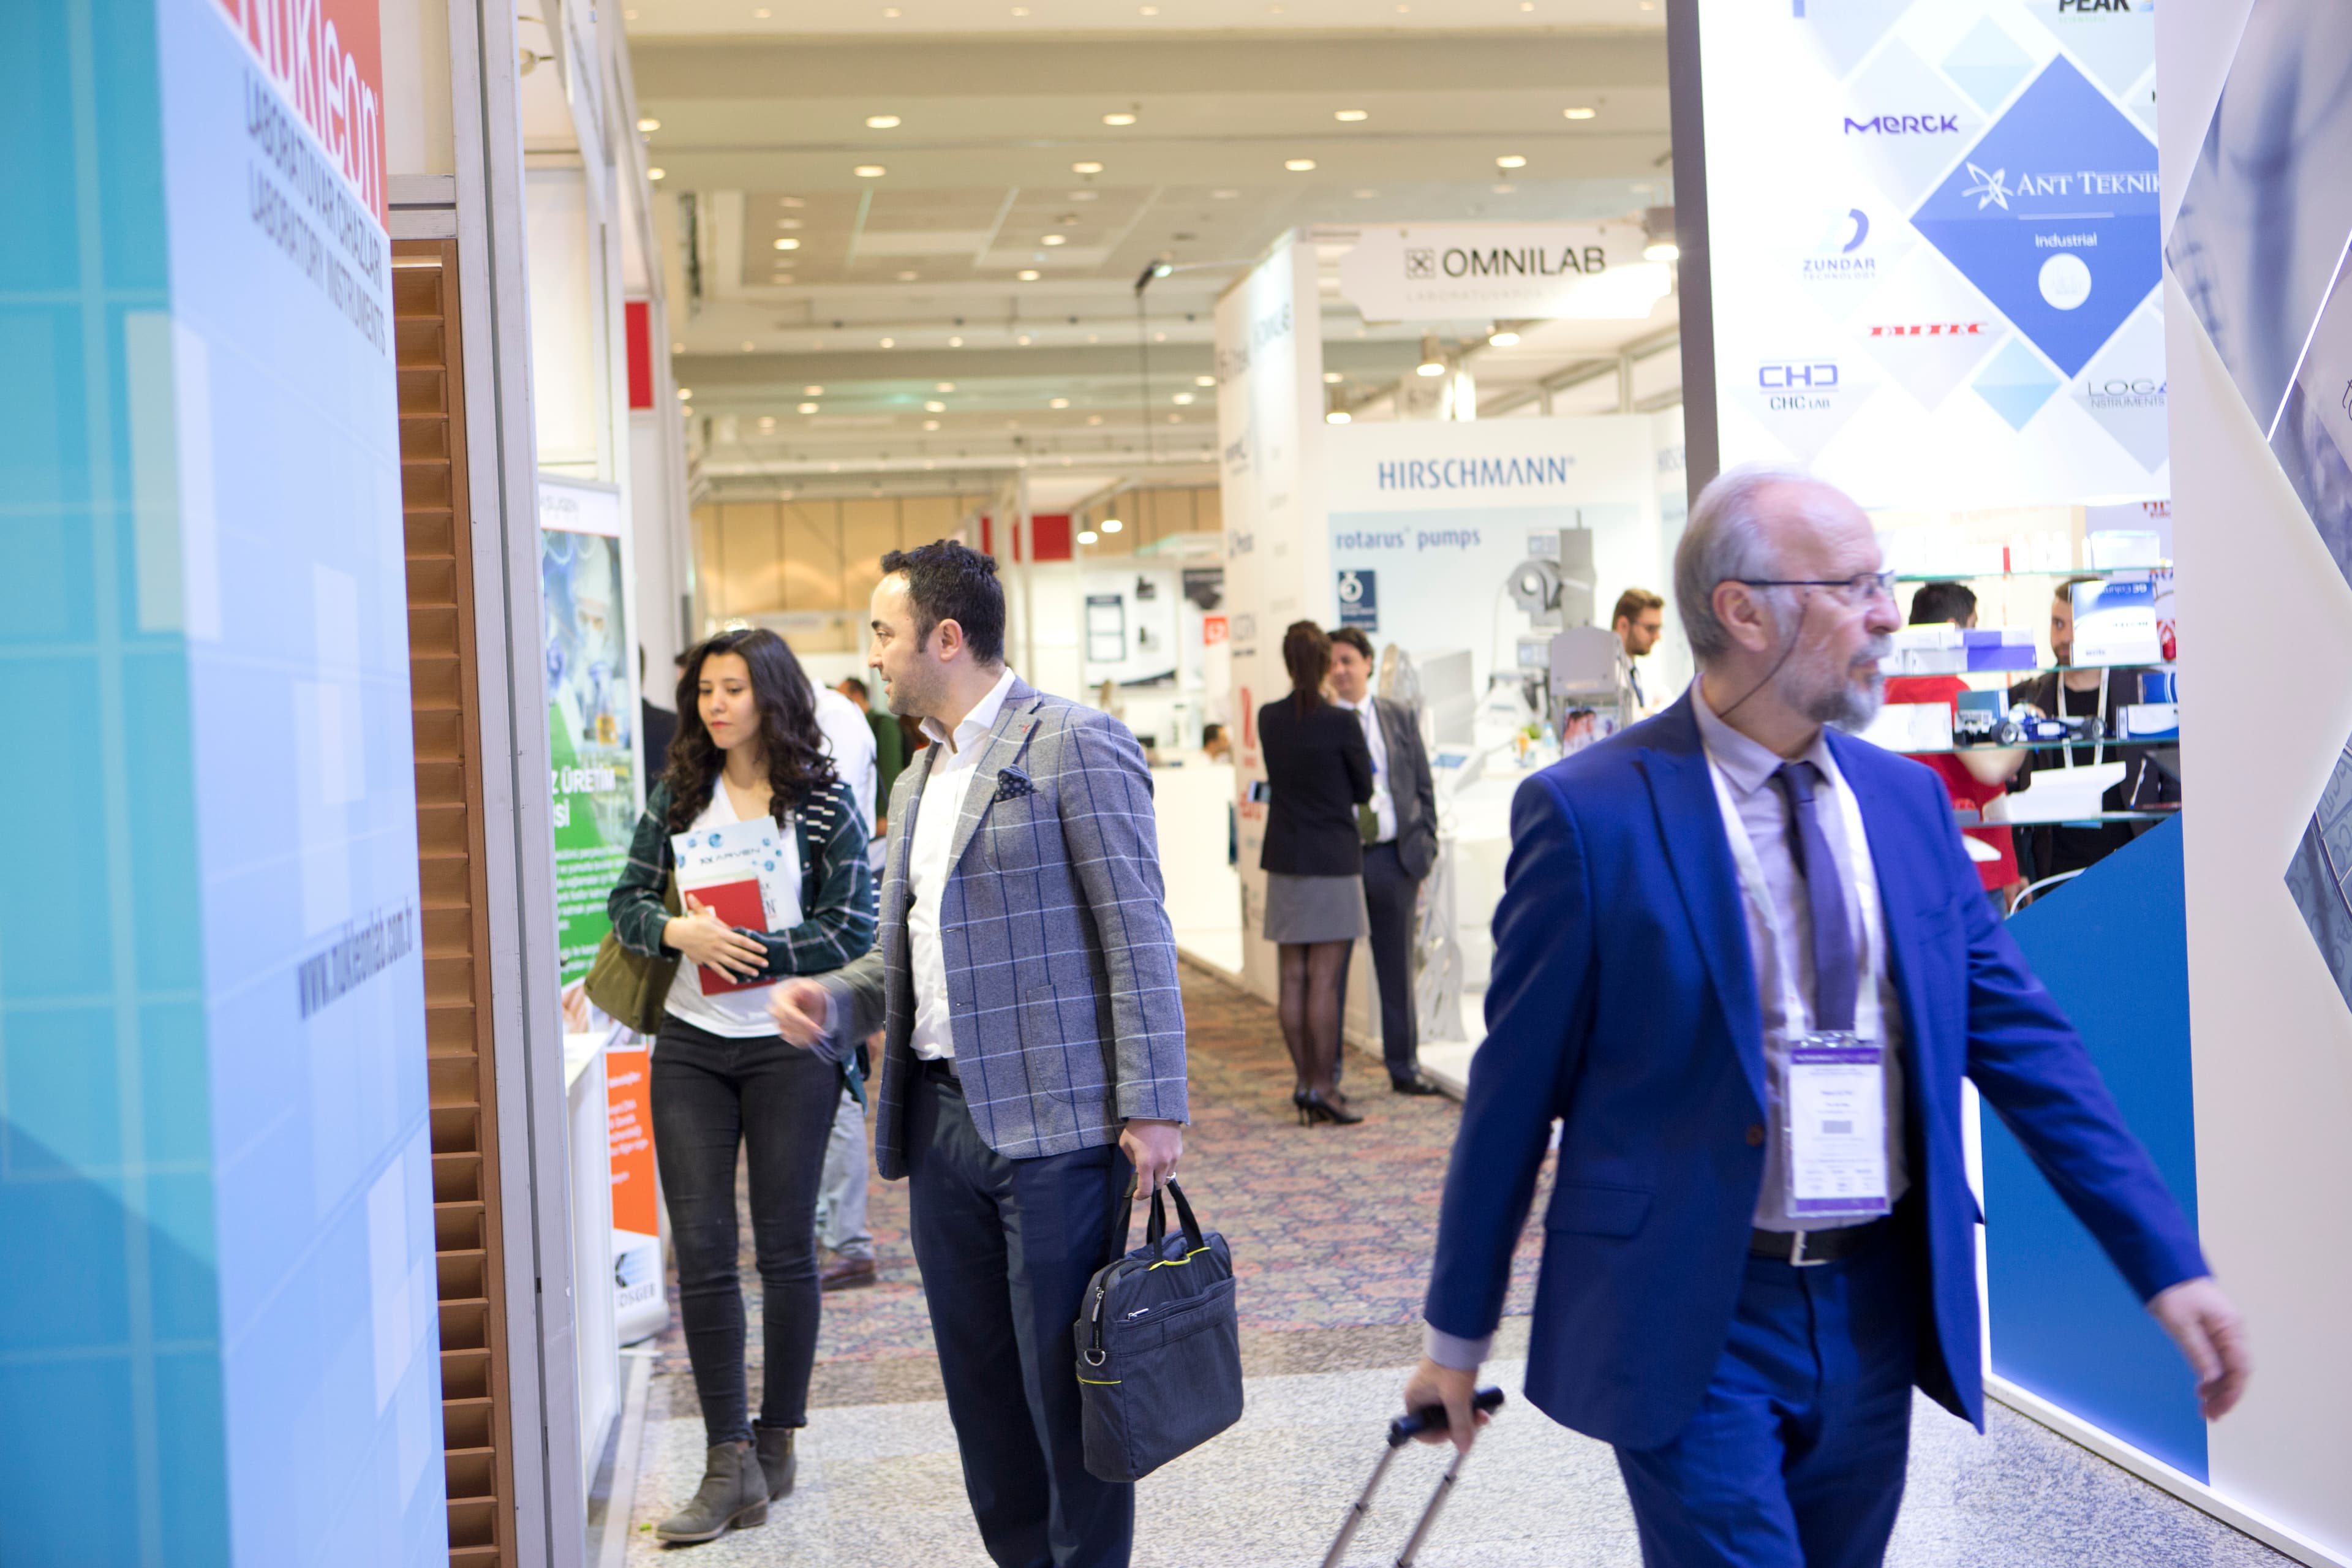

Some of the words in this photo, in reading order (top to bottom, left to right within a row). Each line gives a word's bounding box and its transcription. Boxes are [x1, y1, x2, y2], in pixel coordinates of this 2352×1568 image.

[2018, 172, 2073, 196] ANT
[2035, 232, 2097, 248] Industrial
[1442, 246, 1606, 277] OMNILAB
[1803, 258, 1875, 271] ZUNDAR
[1770, 396, 1805, 410] CHC
[1417, 529, 1480, 552] pumps
